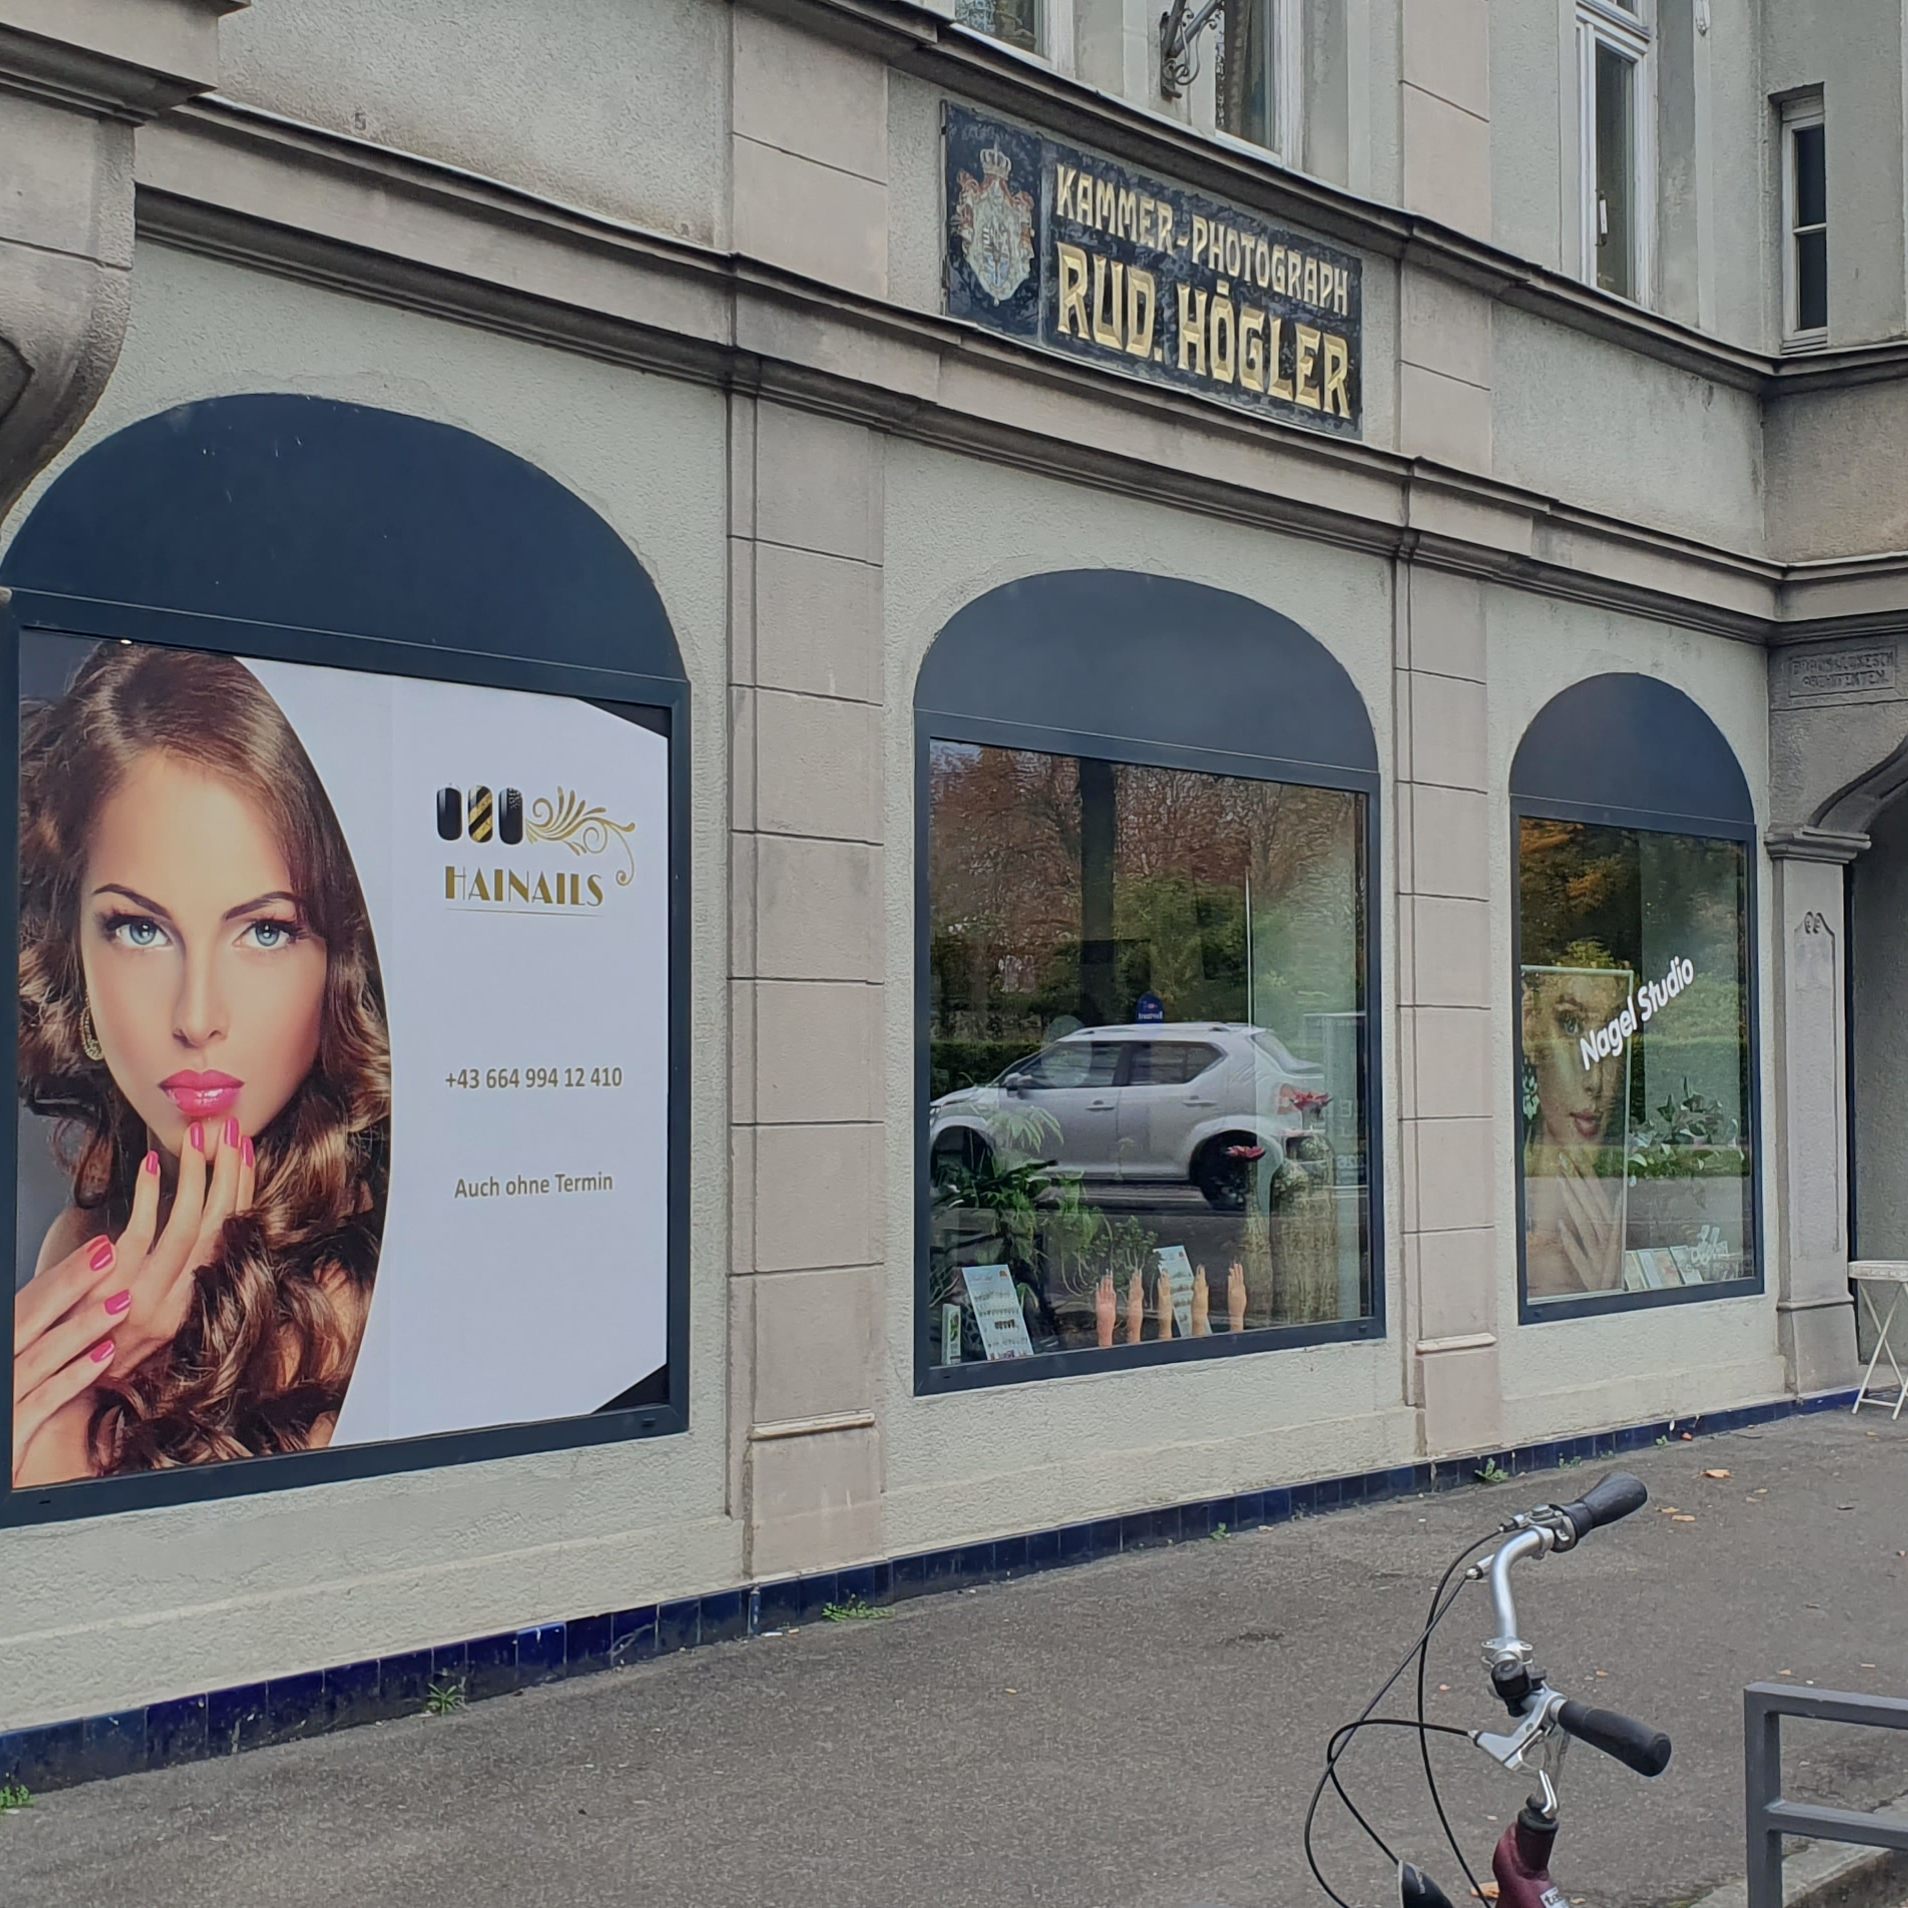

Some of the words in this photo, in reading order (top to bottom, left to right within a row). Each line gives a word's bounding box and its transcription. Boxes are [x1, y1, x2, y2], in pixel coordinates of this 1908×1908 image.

[1055, 164, 1349, 316] KAMMER-PHOTOGRAPH
[1056, 243, 1163, 362] RUD.
[445, 866, 604, 907] HAINAILS
[1580, 995, 1638, 1071] Nagel
[1637, 955, 1694, 1022] Studio
[446, 1069, 480, 1089] +43
[486, 1068, 520, 1089] 664
[525, 1067, 559, 1088] 994
[564, 1067, 585, 1088] 12
[590, 1067, 622, 1087] 410
[454, 1176, 500, 1198] Auch
[505, 1175, 550, 1195] ohne
[555, 1171, 613, 1193] Termin
